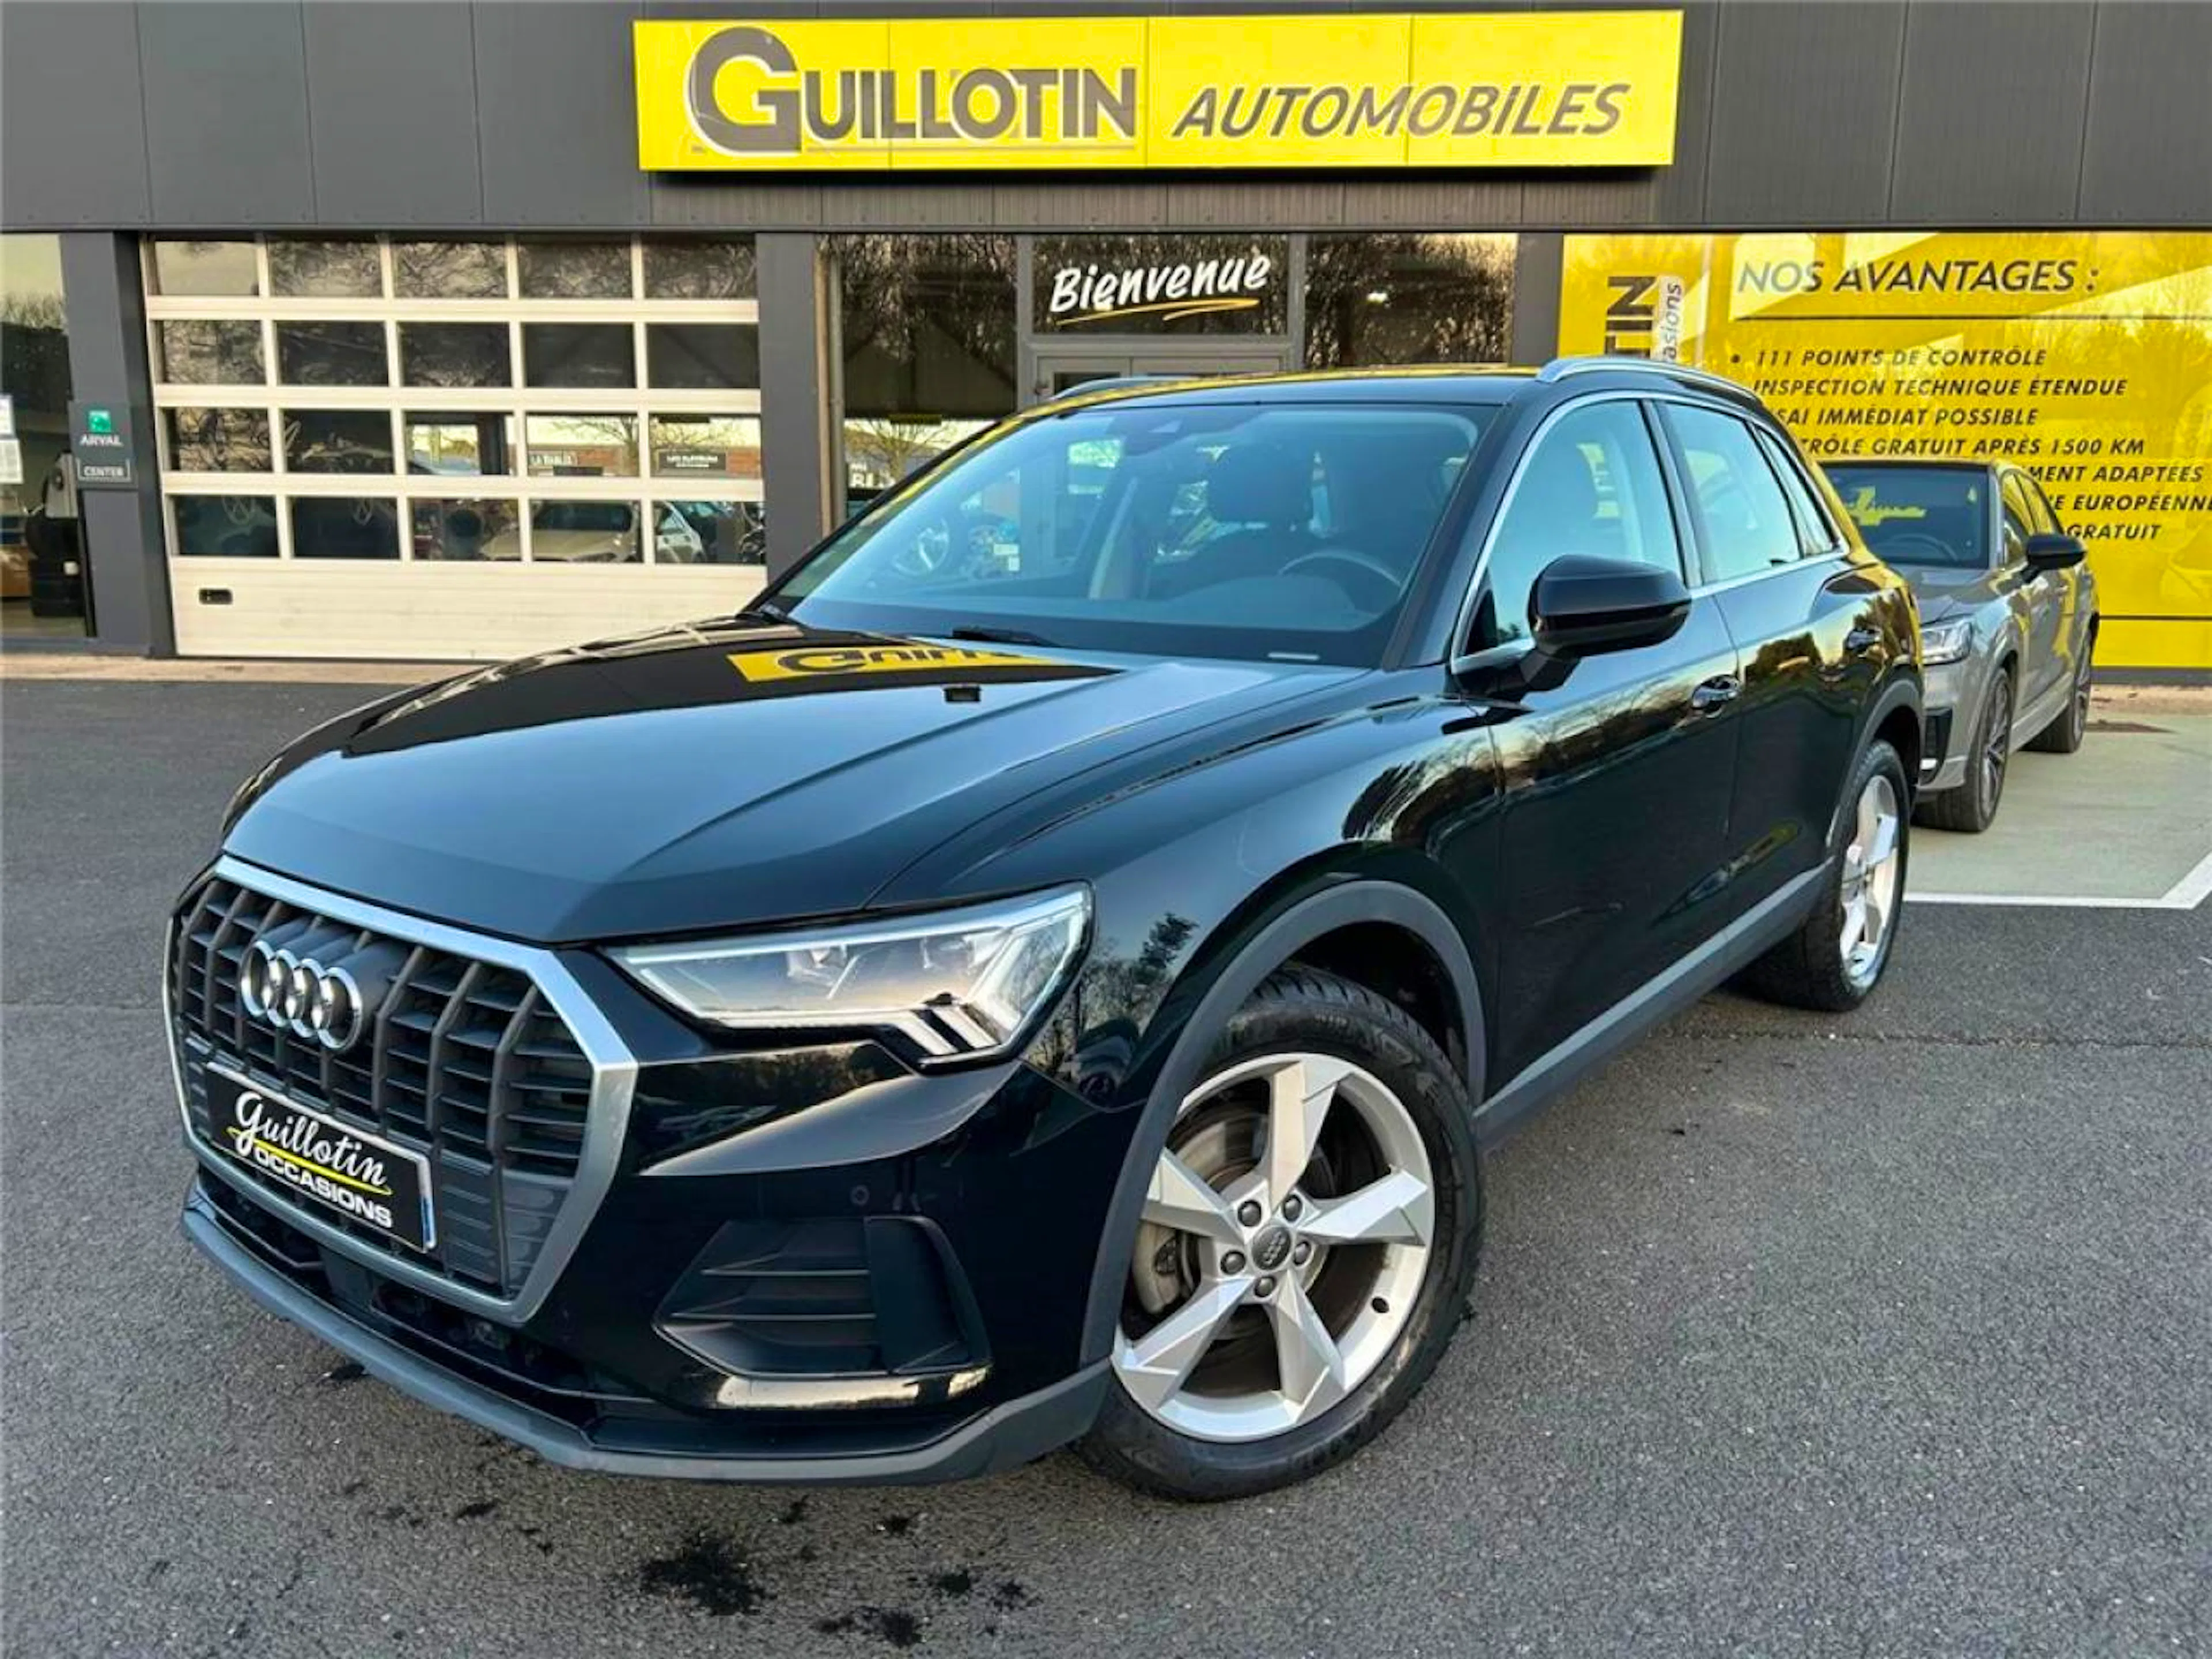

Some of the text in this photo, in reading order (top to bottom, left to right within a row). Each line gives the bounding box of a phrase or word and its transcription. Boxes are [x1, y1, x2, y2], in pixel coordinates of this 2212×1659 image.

[691, 26, 1631, 153] GUILLOTIN AUTOMOBILES
[1050, 254, 1271, 313] Bienvenue
[1738, 262, 1824, 292] NOS
[1833, 260, 2077, 292] AVANTAGES
[1758, 346, 2047, 366] 111 POINTS DE CONTRÔLE
[1754, 375, 2127, 396] INSPECTION TECHNIQUE ÉTENDUE
[1817, 404, 1927, 425] IMMÉDIAT
[1935, 407, 2039, 425] POSSIBLE
[1872, 438, 1966, 454] GRATUIT
[1972, 433, 2041, 454] APRÈS
[2051, 438, 2103, 454] 1500
[2109, 438, 2145, 454] KM
[2067, 524, 2162, 540] GRATUIT
[255, 1147, 392, 1228] OCCASIONS
